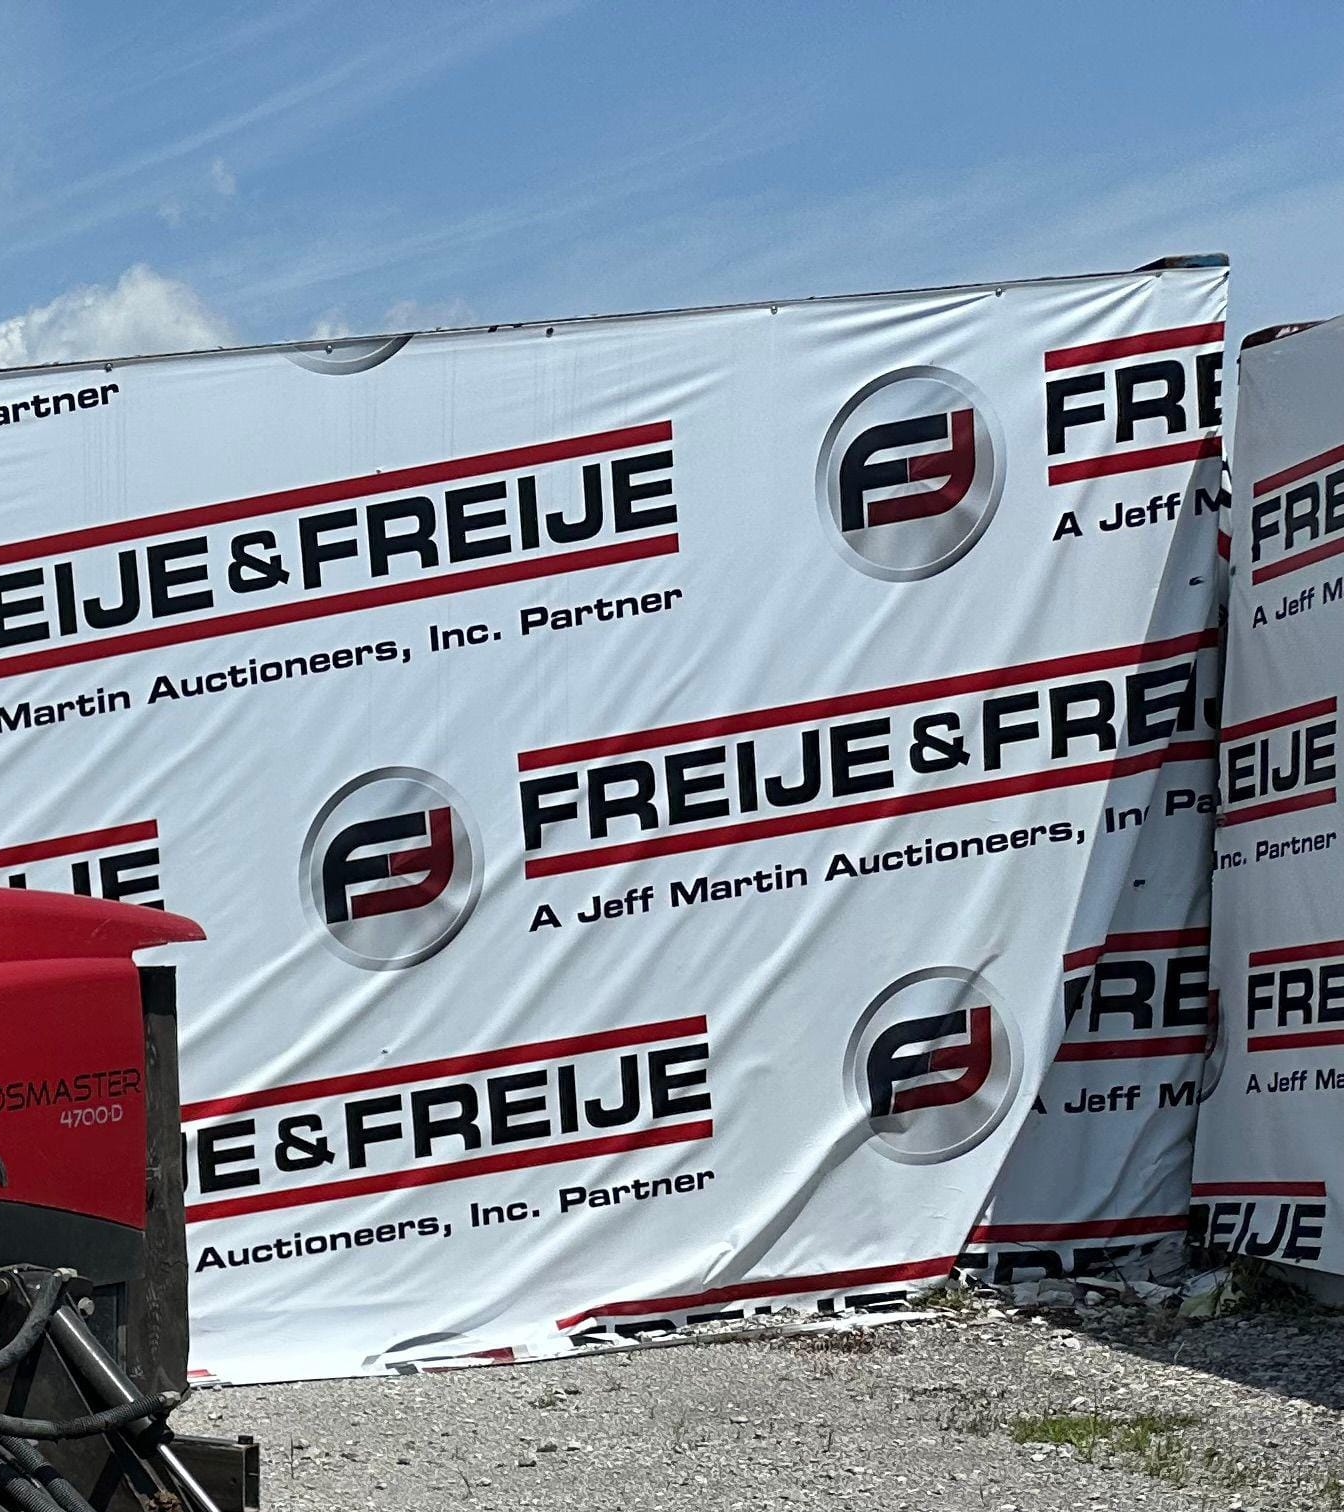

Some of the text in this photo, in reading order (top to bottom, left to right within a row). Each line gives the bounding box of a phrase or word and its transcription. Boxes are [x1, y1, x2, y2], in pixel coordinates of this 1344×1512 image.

[228, 531, 289, 593] &
[299, 450, 677, 590] FREIJE
[1052, 511, 1083, 541] A
[1099, 492, 1181, 532] Jeff
[148, 641, 410, 704] Auctioneers,
[430, 625, 501, 651] Inc.
[521, 589, 682, 635] Partner
[1252, 605, 1268, 629] A
[1275, 587, 1315, 620] Jeff
[520, 717, 894, 851] FREIJE
[910, 712, 970, 773] &
[529, 904, 562, 932] A
[578, 886, 653, 922] Jeff
[671, 865, 807, 907] Martin
[825, 823, 1084, 881] Auctioneers,
[1256, 831, 1337, 862] Partner
[1248, 964, 1344, 1030] FRE
[275, 1114, 335, 1172] &
[345, 1043, 711, 1169] FREIJE
[1064, 1086, 1140, 1113] Jeff
[1246, 1074, 1261, 1094] A
[1267, 1071, 1308, 1093] Jeff
[195, 1171, 714, 1272] Auctioneers, Inc. Partner
